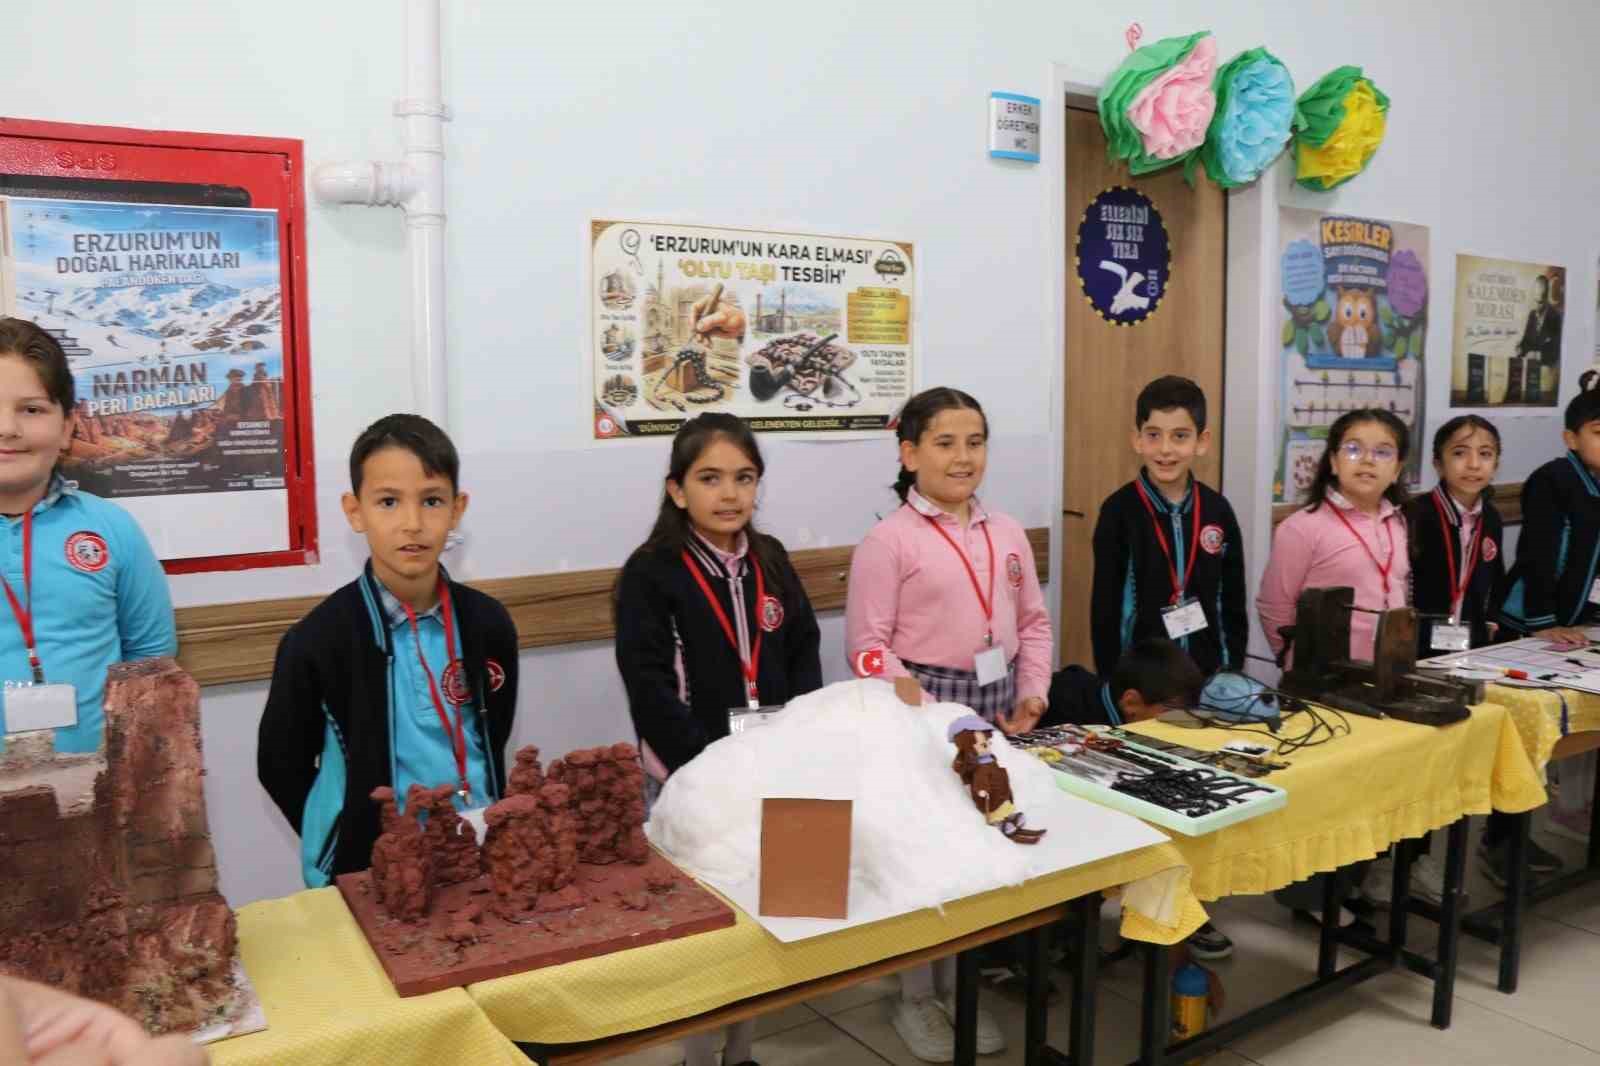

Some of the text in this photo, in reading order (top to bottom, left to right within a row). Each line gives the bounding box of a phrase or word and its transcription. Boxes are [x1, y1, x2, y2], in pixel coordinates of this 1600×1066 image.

[73, 231, 220, 253] ERZURUM'UN
[767, 241, 810, 261] KARA
[56, 250, 240, 274] DOĞAL HARİKALARI
[93, 361, 207, 398] NARMAN
